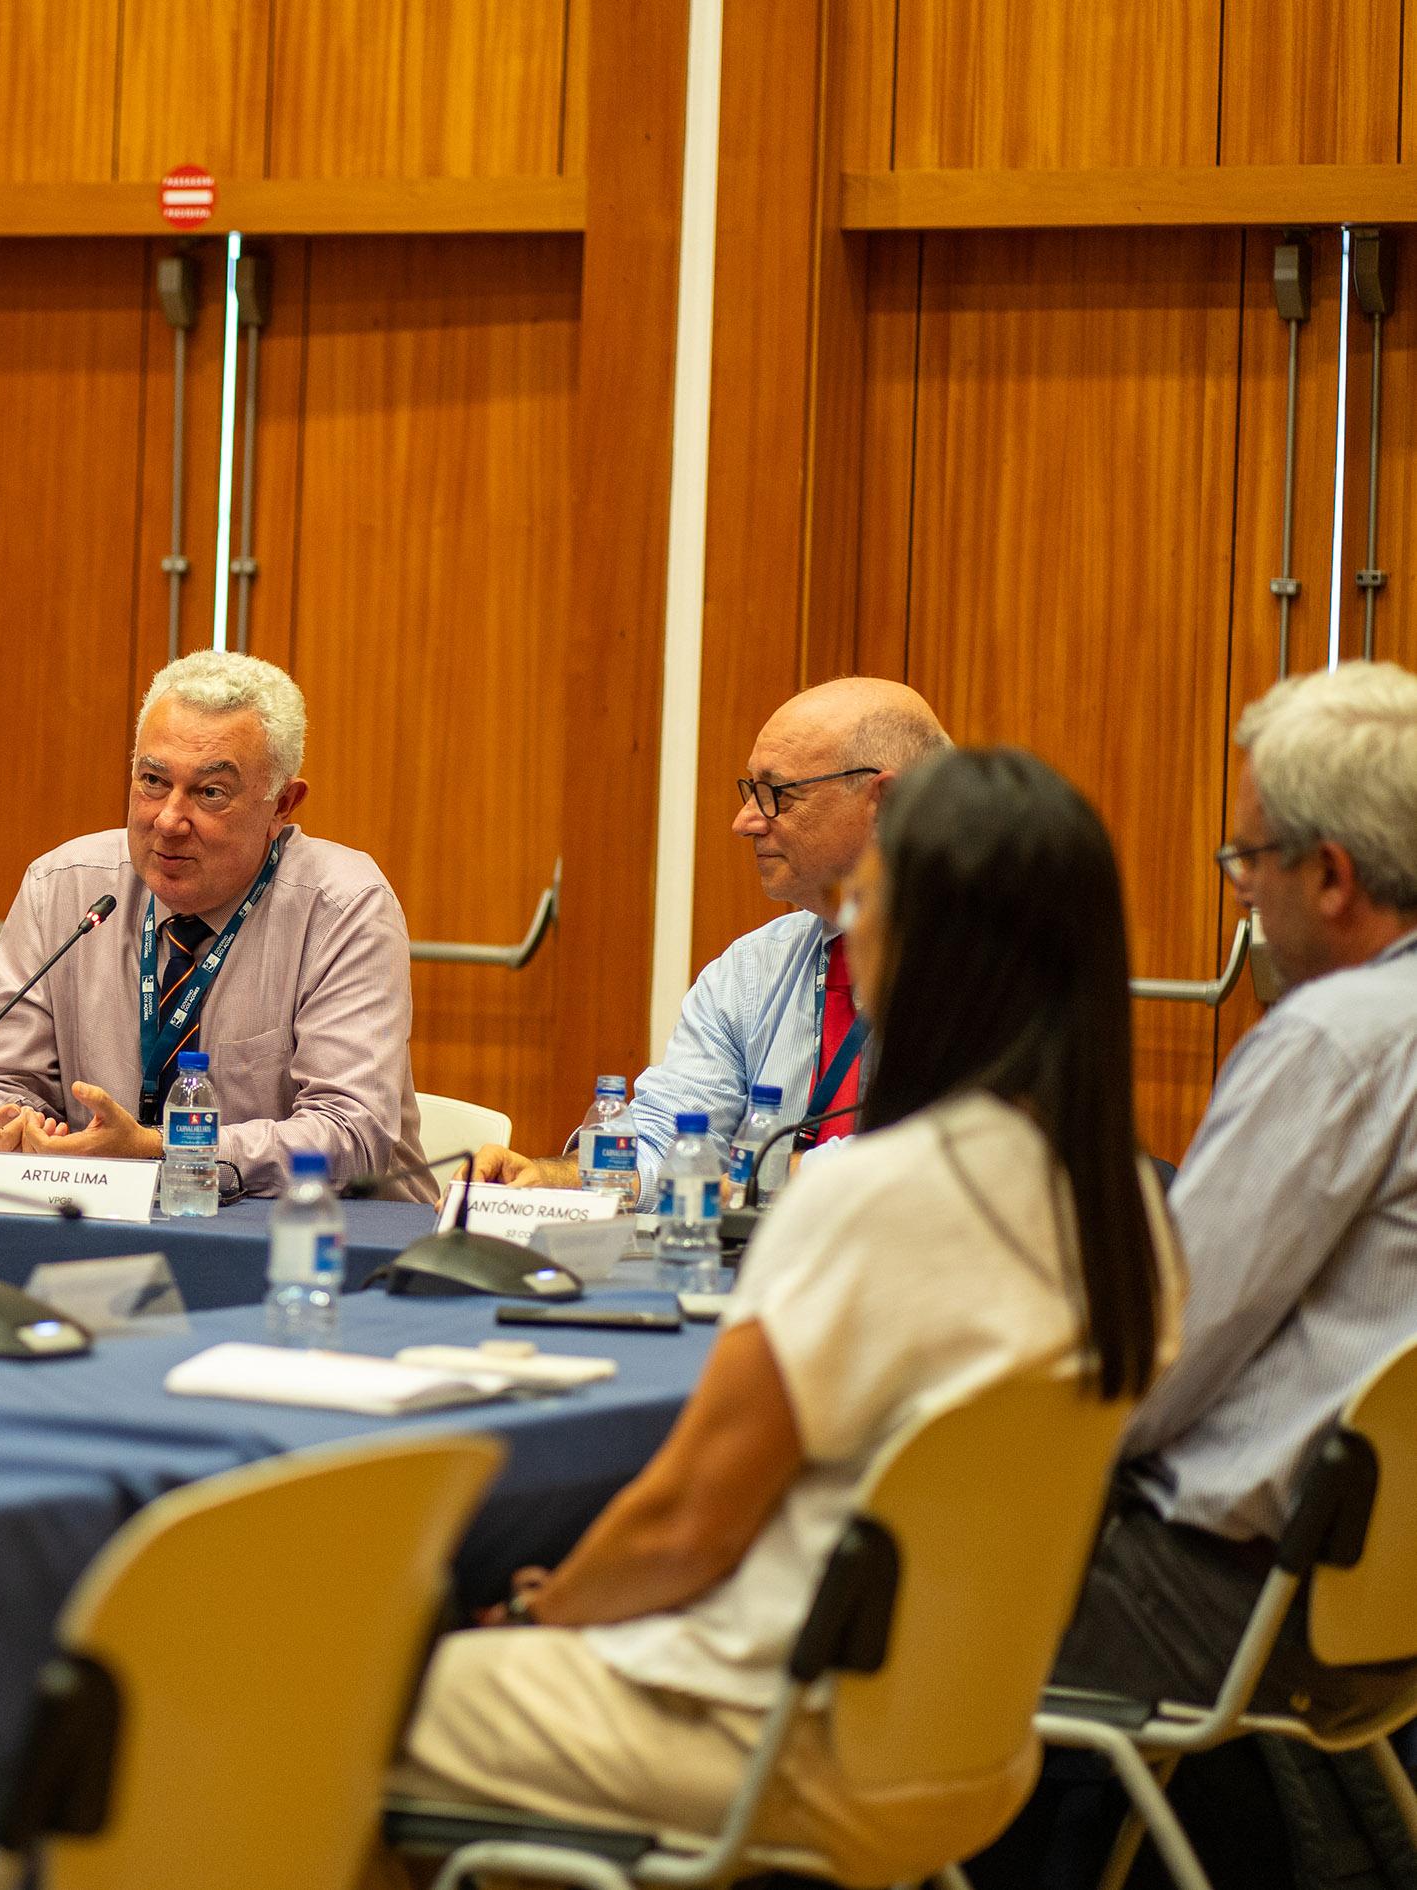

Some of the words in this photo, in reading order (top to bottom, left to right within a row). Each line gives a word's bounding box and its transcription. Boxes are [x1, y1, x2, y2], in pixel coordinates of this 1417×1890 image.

[21, 1169, 69, 1184] ARTUR
[74, 1171, 108, 1186] LIMA
[536, 1206, 590, 1222] RAMOS
